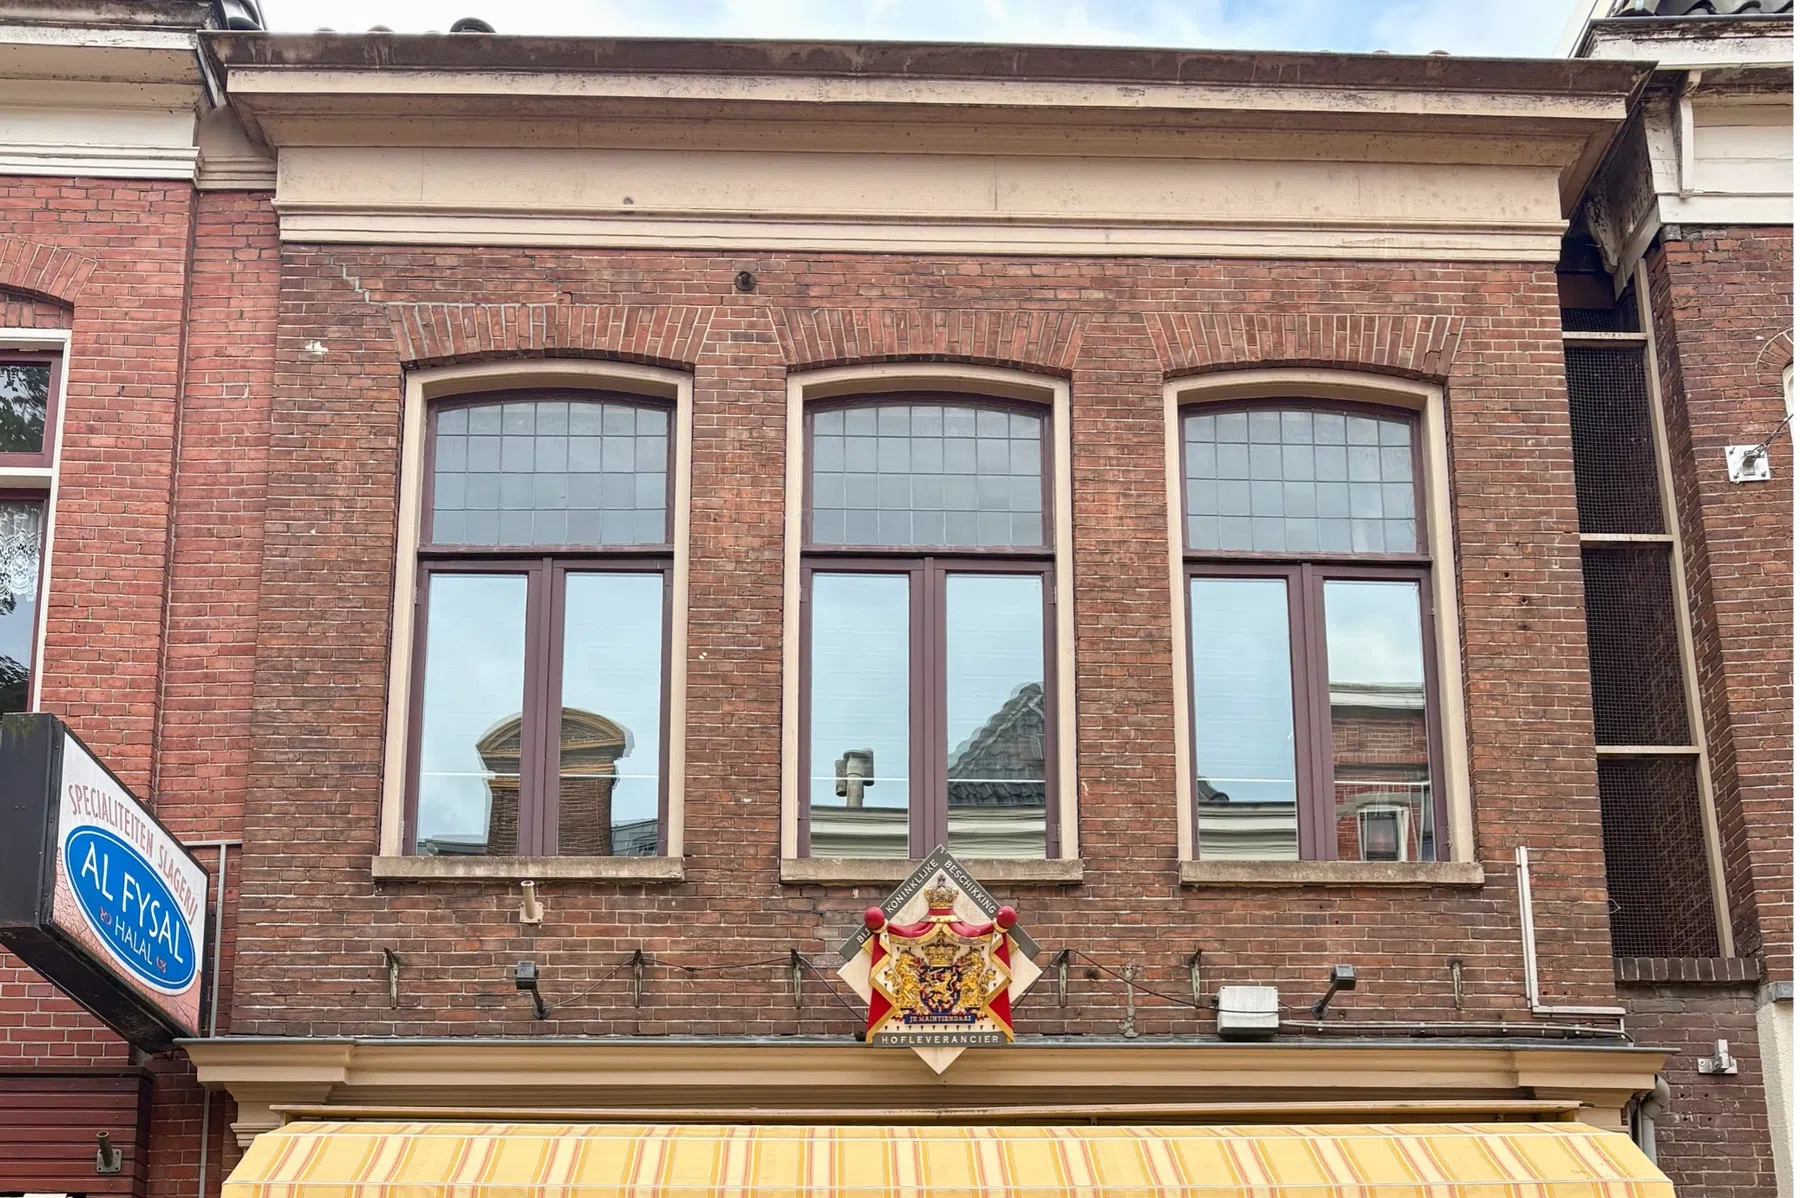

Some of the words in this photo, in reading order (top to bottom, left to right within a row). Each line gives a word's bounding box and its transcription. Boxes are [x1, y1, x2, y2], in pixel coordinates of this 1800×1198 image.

[68, 783, 155, 858] SPECIALITEITEN
[158, 844, 198, 926] SLAGERIJ
[81, 841, 114, 901] AL
[121, 871, 184, 965] FYSAL
[114, 915, 153, 966] HALAL
[855, 928, 872, 945] BIJ
[885, 858, 939, 914] KONINKLIJKE
[943, 859, 997, 915] BESCHIKKING
[881, 1035, 999, 1044] HOFLEVERANCIER
